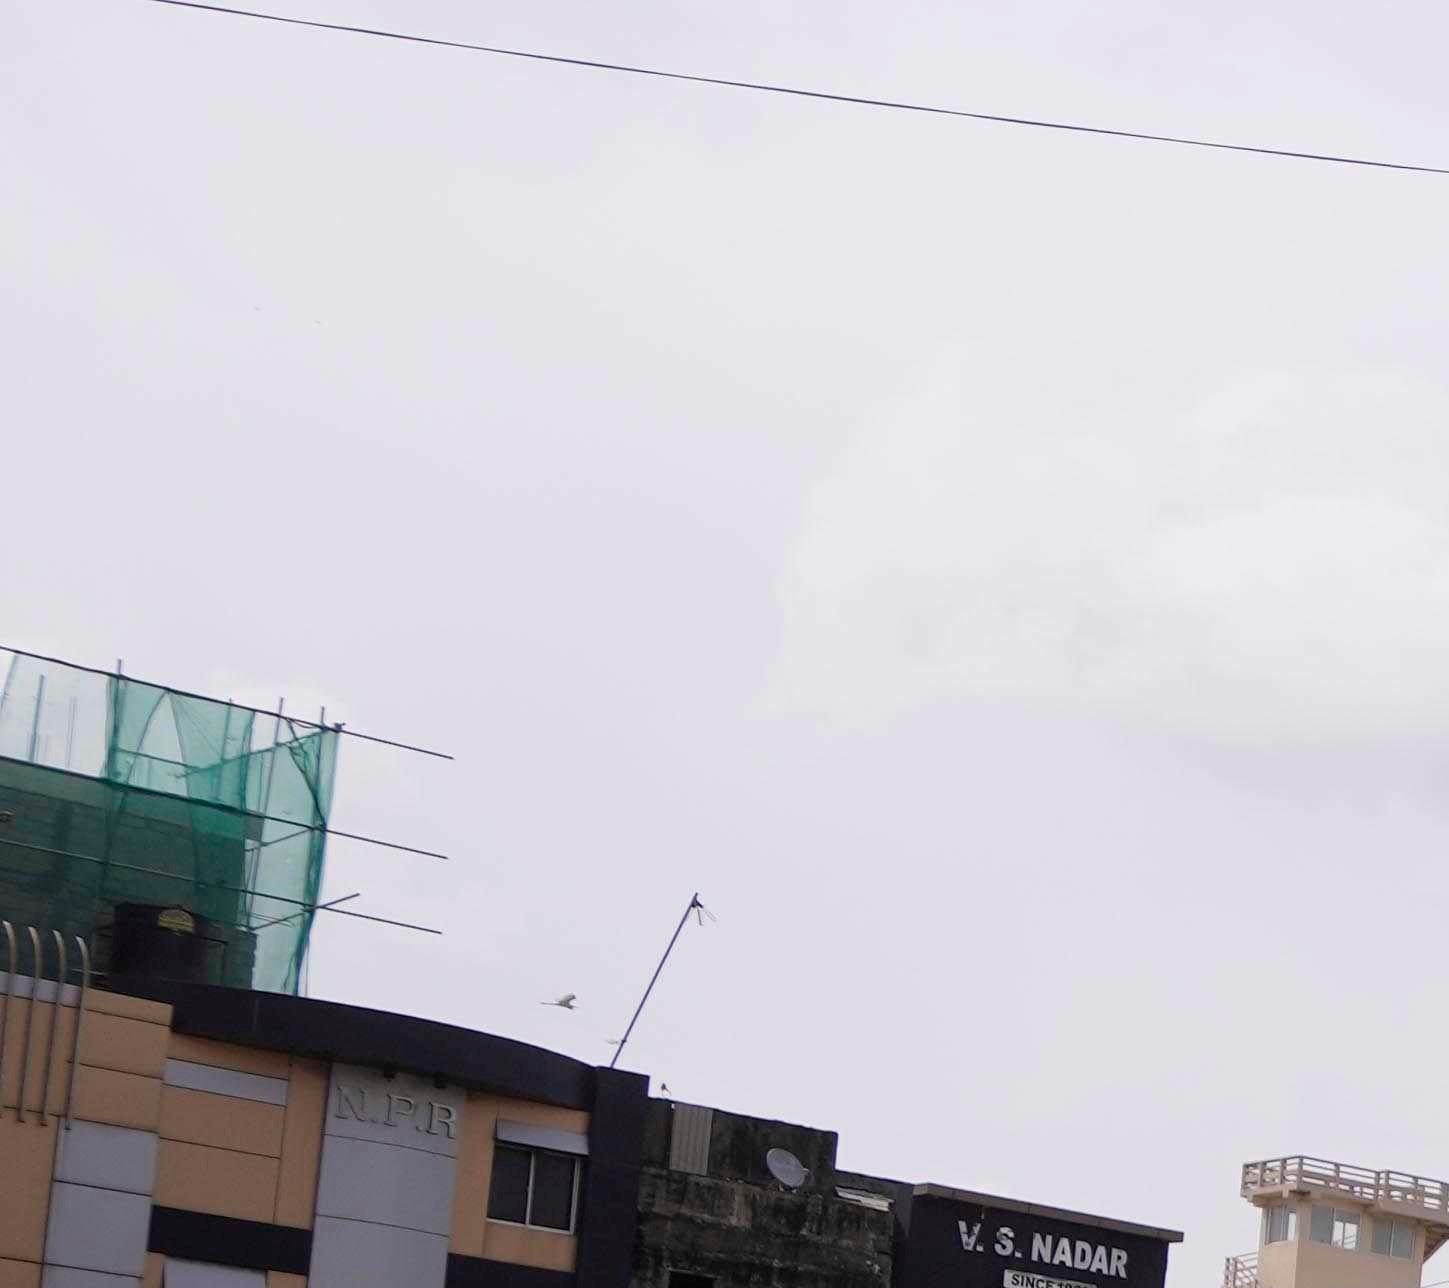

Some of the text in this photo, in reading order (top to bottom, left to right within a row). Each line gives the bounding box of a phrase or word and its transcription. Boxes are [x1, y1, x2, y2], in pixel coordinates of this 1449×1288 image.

[334, 1086, 457, 1140] N.P.R
[957, 1220, 1128, 1279] V. S. NADAR
